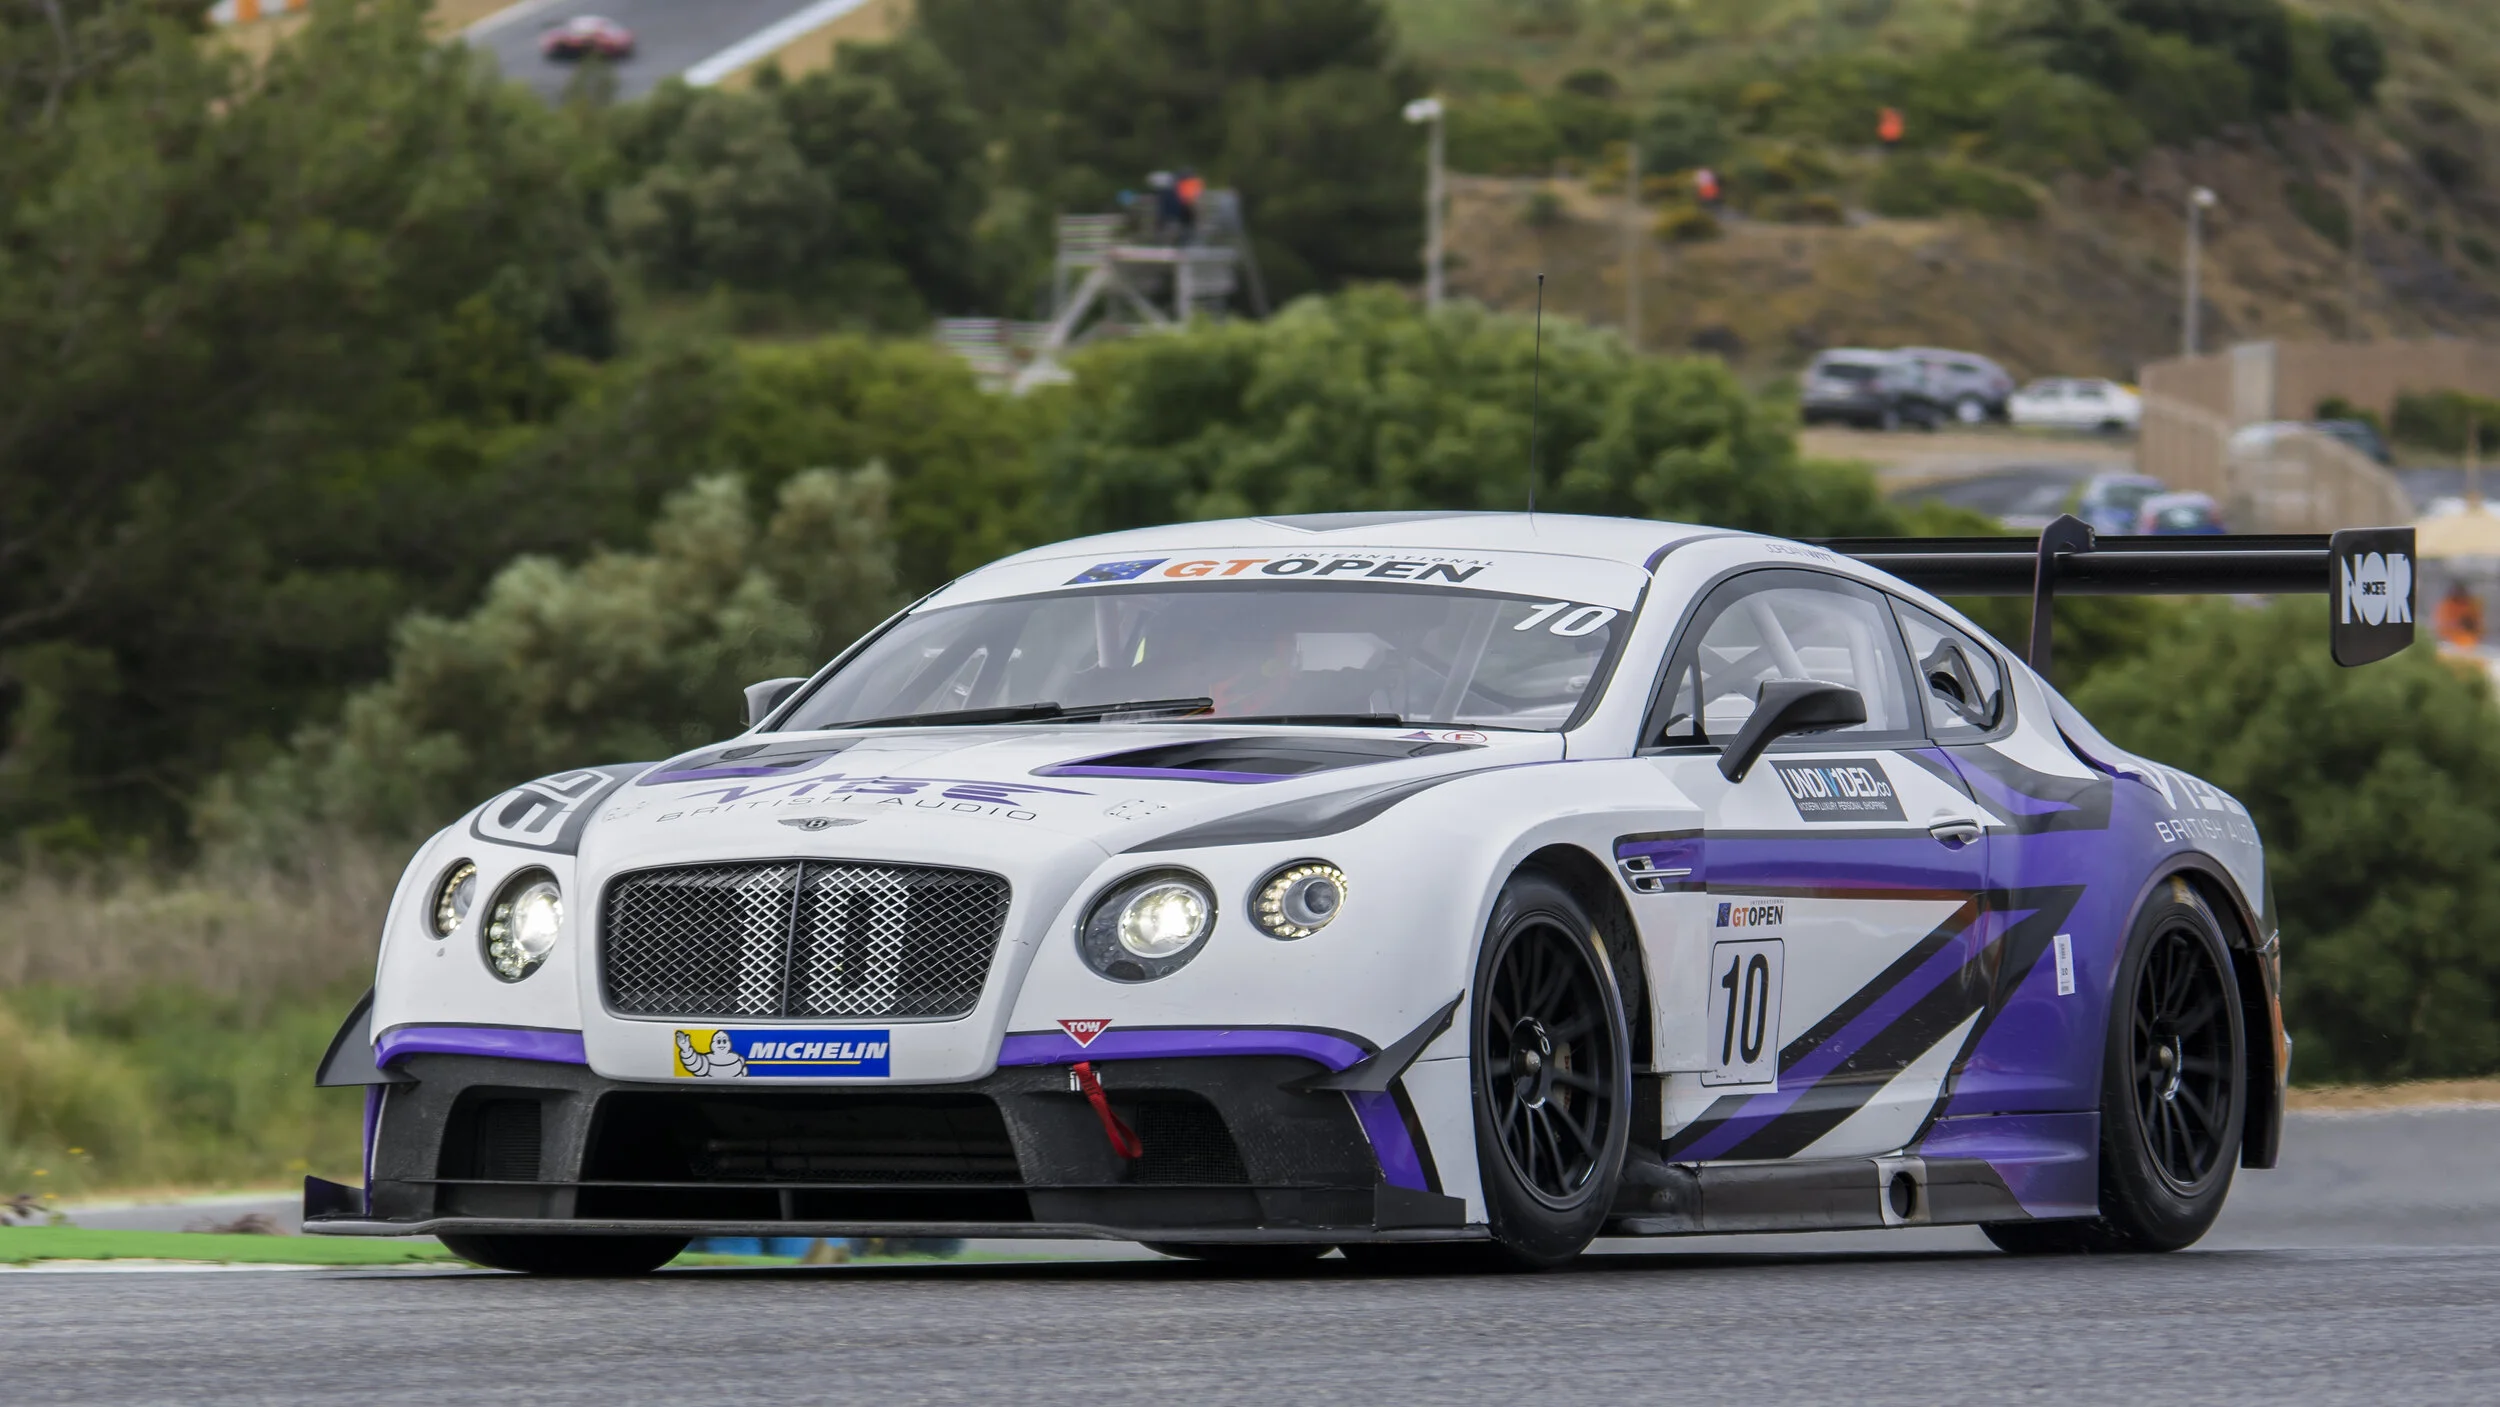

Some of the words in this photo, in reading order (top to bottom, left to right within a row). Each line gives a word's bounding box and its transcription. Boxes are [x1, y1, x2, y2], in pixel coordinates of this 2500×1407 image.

[1286, 552, 1495, 567] INTERNATIONAL
[2341, 552, 2413, 626] NOIR
[1513, 602, 1618, 636] 10
[656, 795, 852, 822] BRITISH
[877, 797, 1037, 821] AUDIO
[2155, 818, 2225, 843] BRITISH
[736, 866, 911, 1015] 10
[1722, 953, 1769, 1066] 10
[1068, 1021, 1101, 1033] TOW
[748, 1042, 888, 1059] MICHELIN
